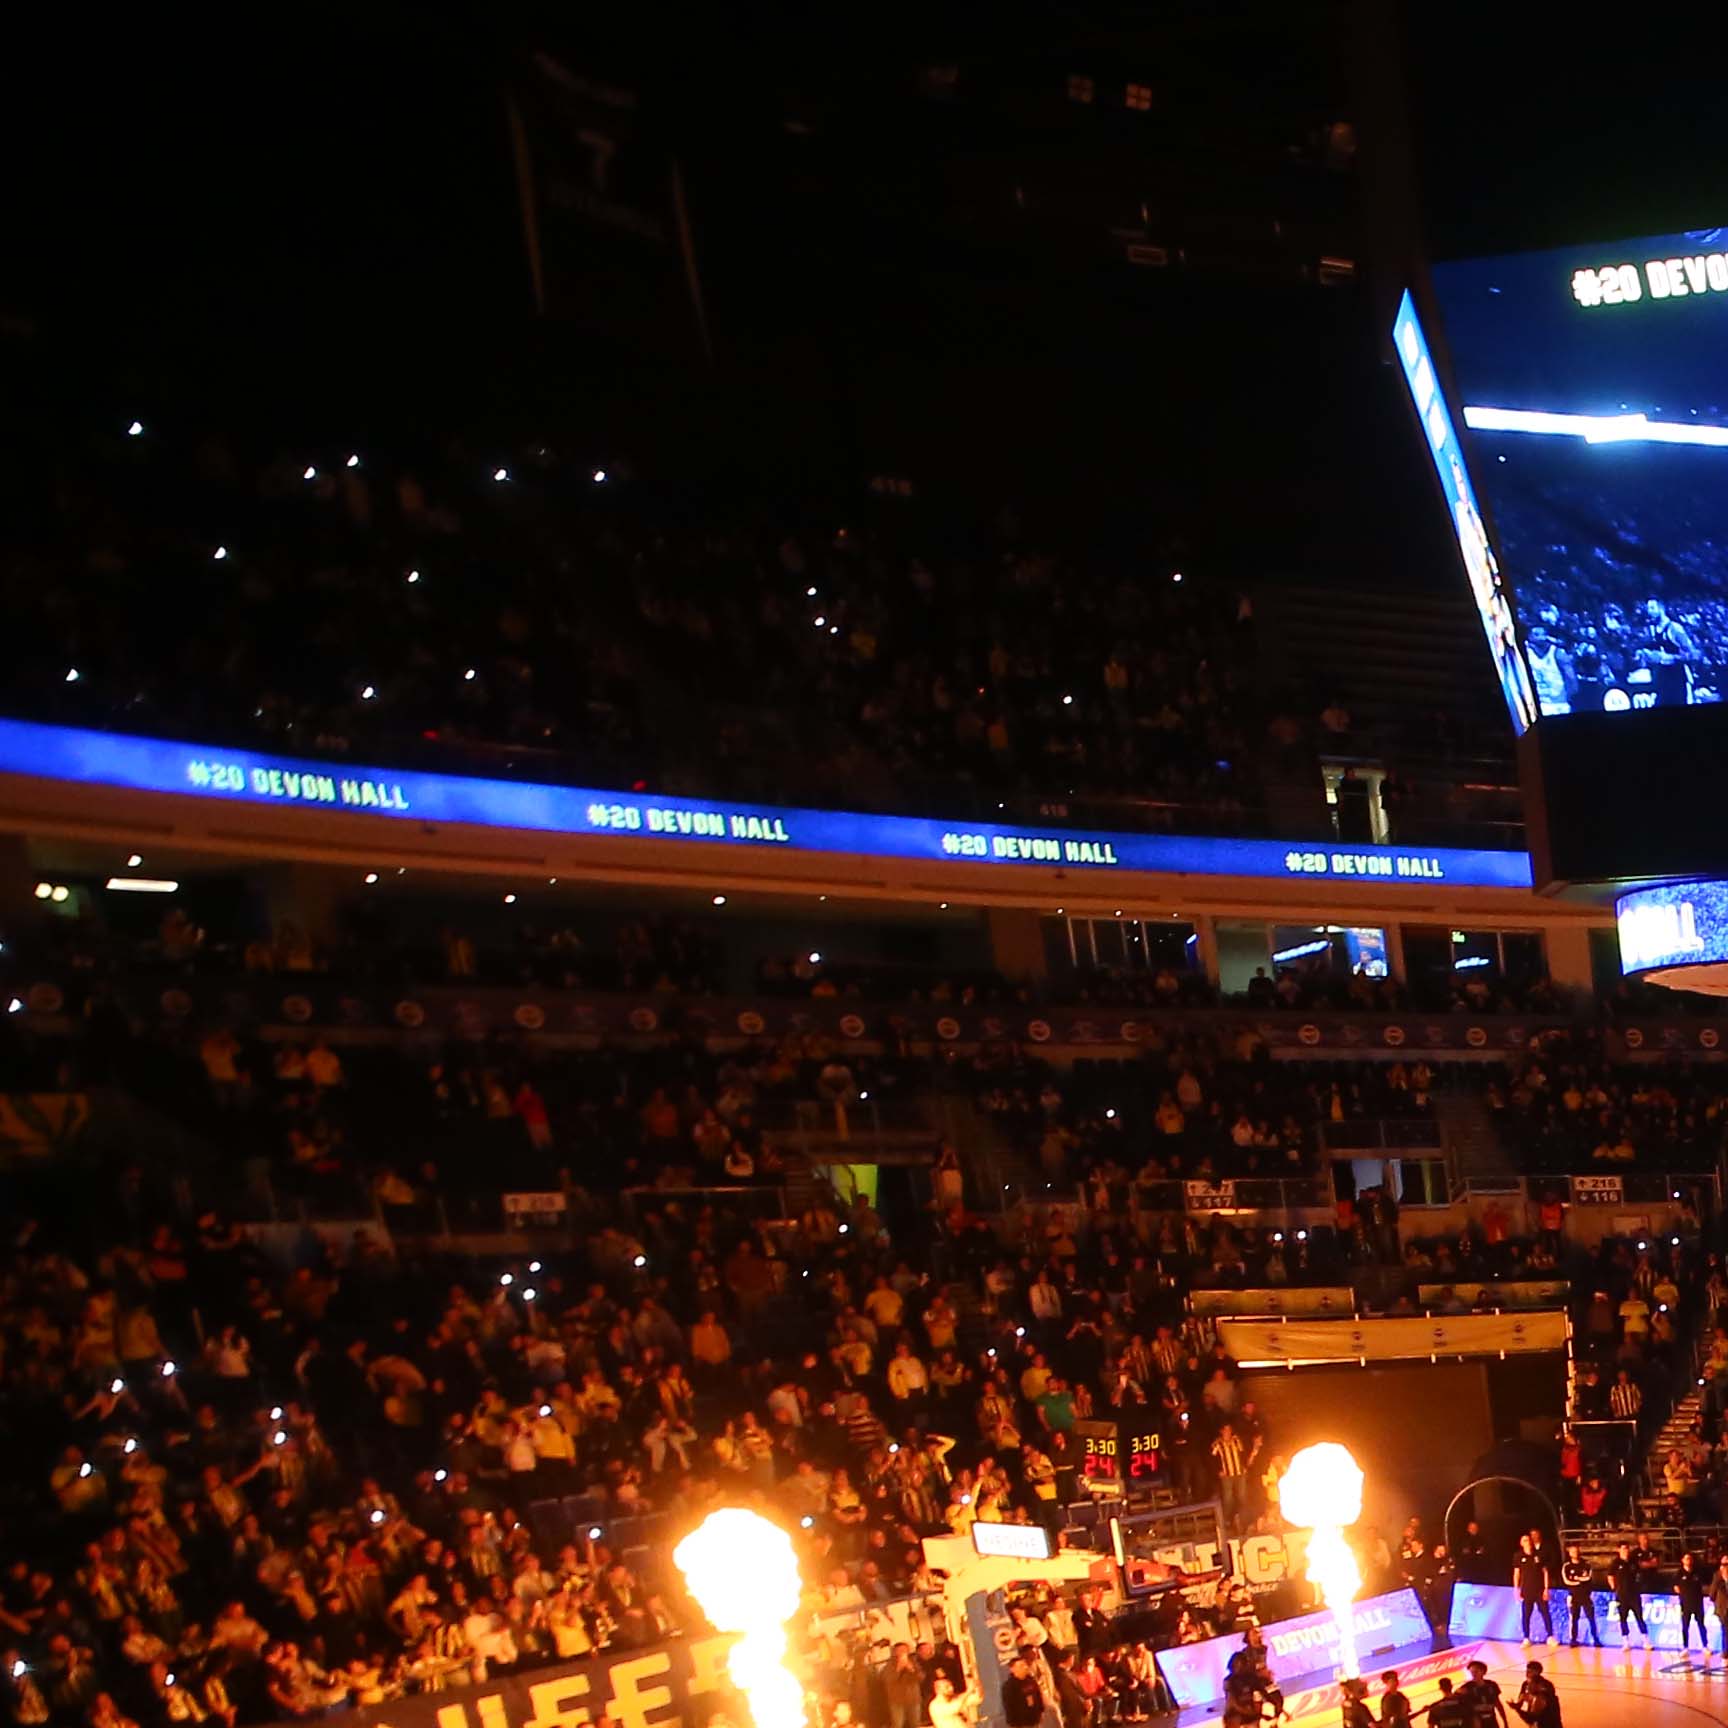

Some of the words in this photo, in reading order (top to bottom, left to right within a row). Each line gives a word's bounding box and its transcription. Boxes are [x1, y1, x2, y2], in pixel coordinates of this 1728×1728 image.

[1571, 263, 1642, 307] #20
[186, 761, 244, 791] #20
[250, 768, 335, 801] DEVON
[341, 780, 409, 809] HALL
[586, 803, 640, 830] #20
[645, 808, 725, 836] DEVON
[730, 815, 789, 841] HALL
[941, 833, 987, 856] #20
[992, 836, 1060, 860] DEVON
[1065, 841, 1117, 864] HALL
[1285, 852, 1327, 873] #20
[1331, 854, 1393, 875] DEVON
[1396, 857, 1443, 877] HALL
[1130, 1433, 1160, 1453] 3:30
[1129, 1453, 1159, 1477] 24
[1273, 1623, 1345, 1658] DEVO
[1345, 1608, 1392, 1637] ALL
